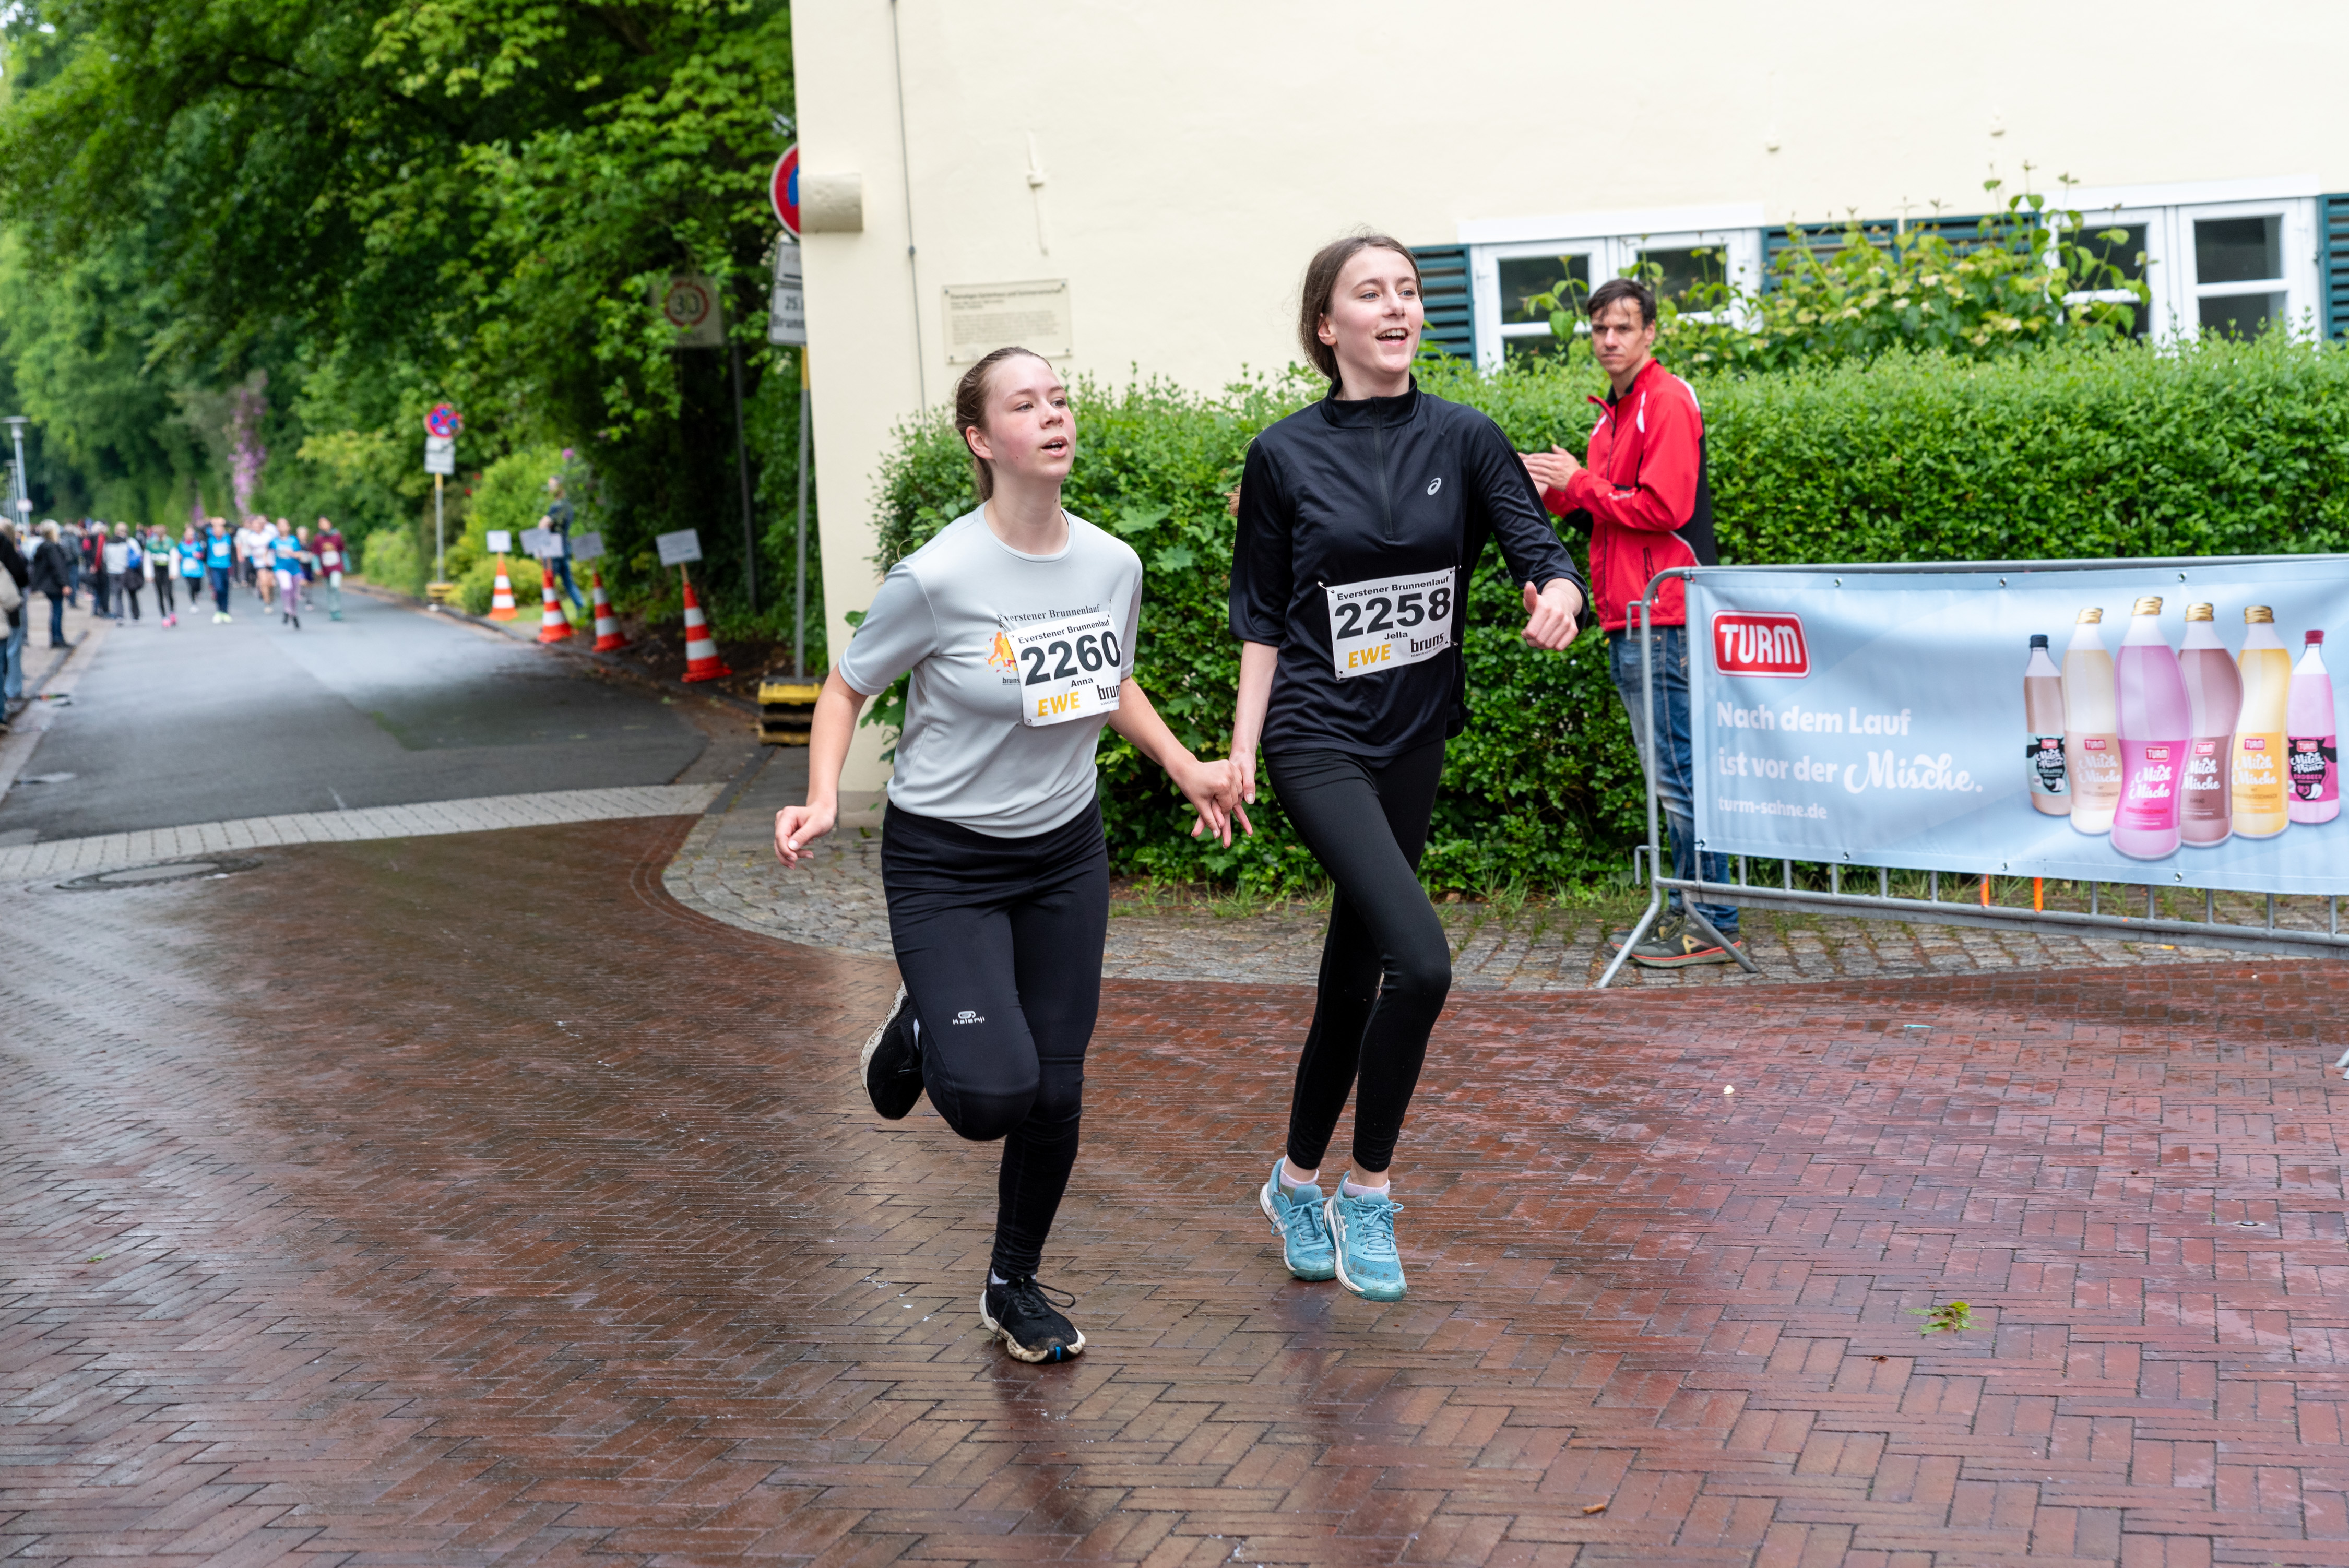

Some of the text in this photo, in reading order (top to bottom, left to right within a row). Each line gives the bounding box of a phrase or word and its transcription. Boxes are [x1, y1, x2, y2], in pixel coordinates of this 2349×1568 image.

[1337, 576, 1449, 601] Everstener Brunnenlauf
[996, 604, 1100, 622] Everstener Brunnenlauf
[1335, 587, 1451, 640] 2258
[1018, 619, 1110, 644] Everstener Brunnenlauf
[1384, 631, 1408, 640] Jella
[1410, 632, 1444, 653] bruns
[1719, 624, 1801, 664] TURM
[1021, 631, 1121, 686] 2260
[1348, 643, 1391, 669] EWE
[1071, 677, 1094, 688] Anna
[1096, 684, 1121, 700] brun
[1038, 691, 1081, 717] EWE
[1716, 701, 1912, 736] Nach dem Lauf
[2078, 753, 2118, 770] Milch
[2147, 749, 2168, 759] TURM
[2234, 753, 2274, 770] Milch
[2289, 752, 2323, 766] Milch
[1718, 747, 1983, 794] ist vor der Mische.
[2135, 764, 2172, 782] Milch
[2189, 757, 2218, 775] Milch
[2129, 783, 2170, 800] Mische
[1718, 795, 1828, 819] turm-sahne.de
